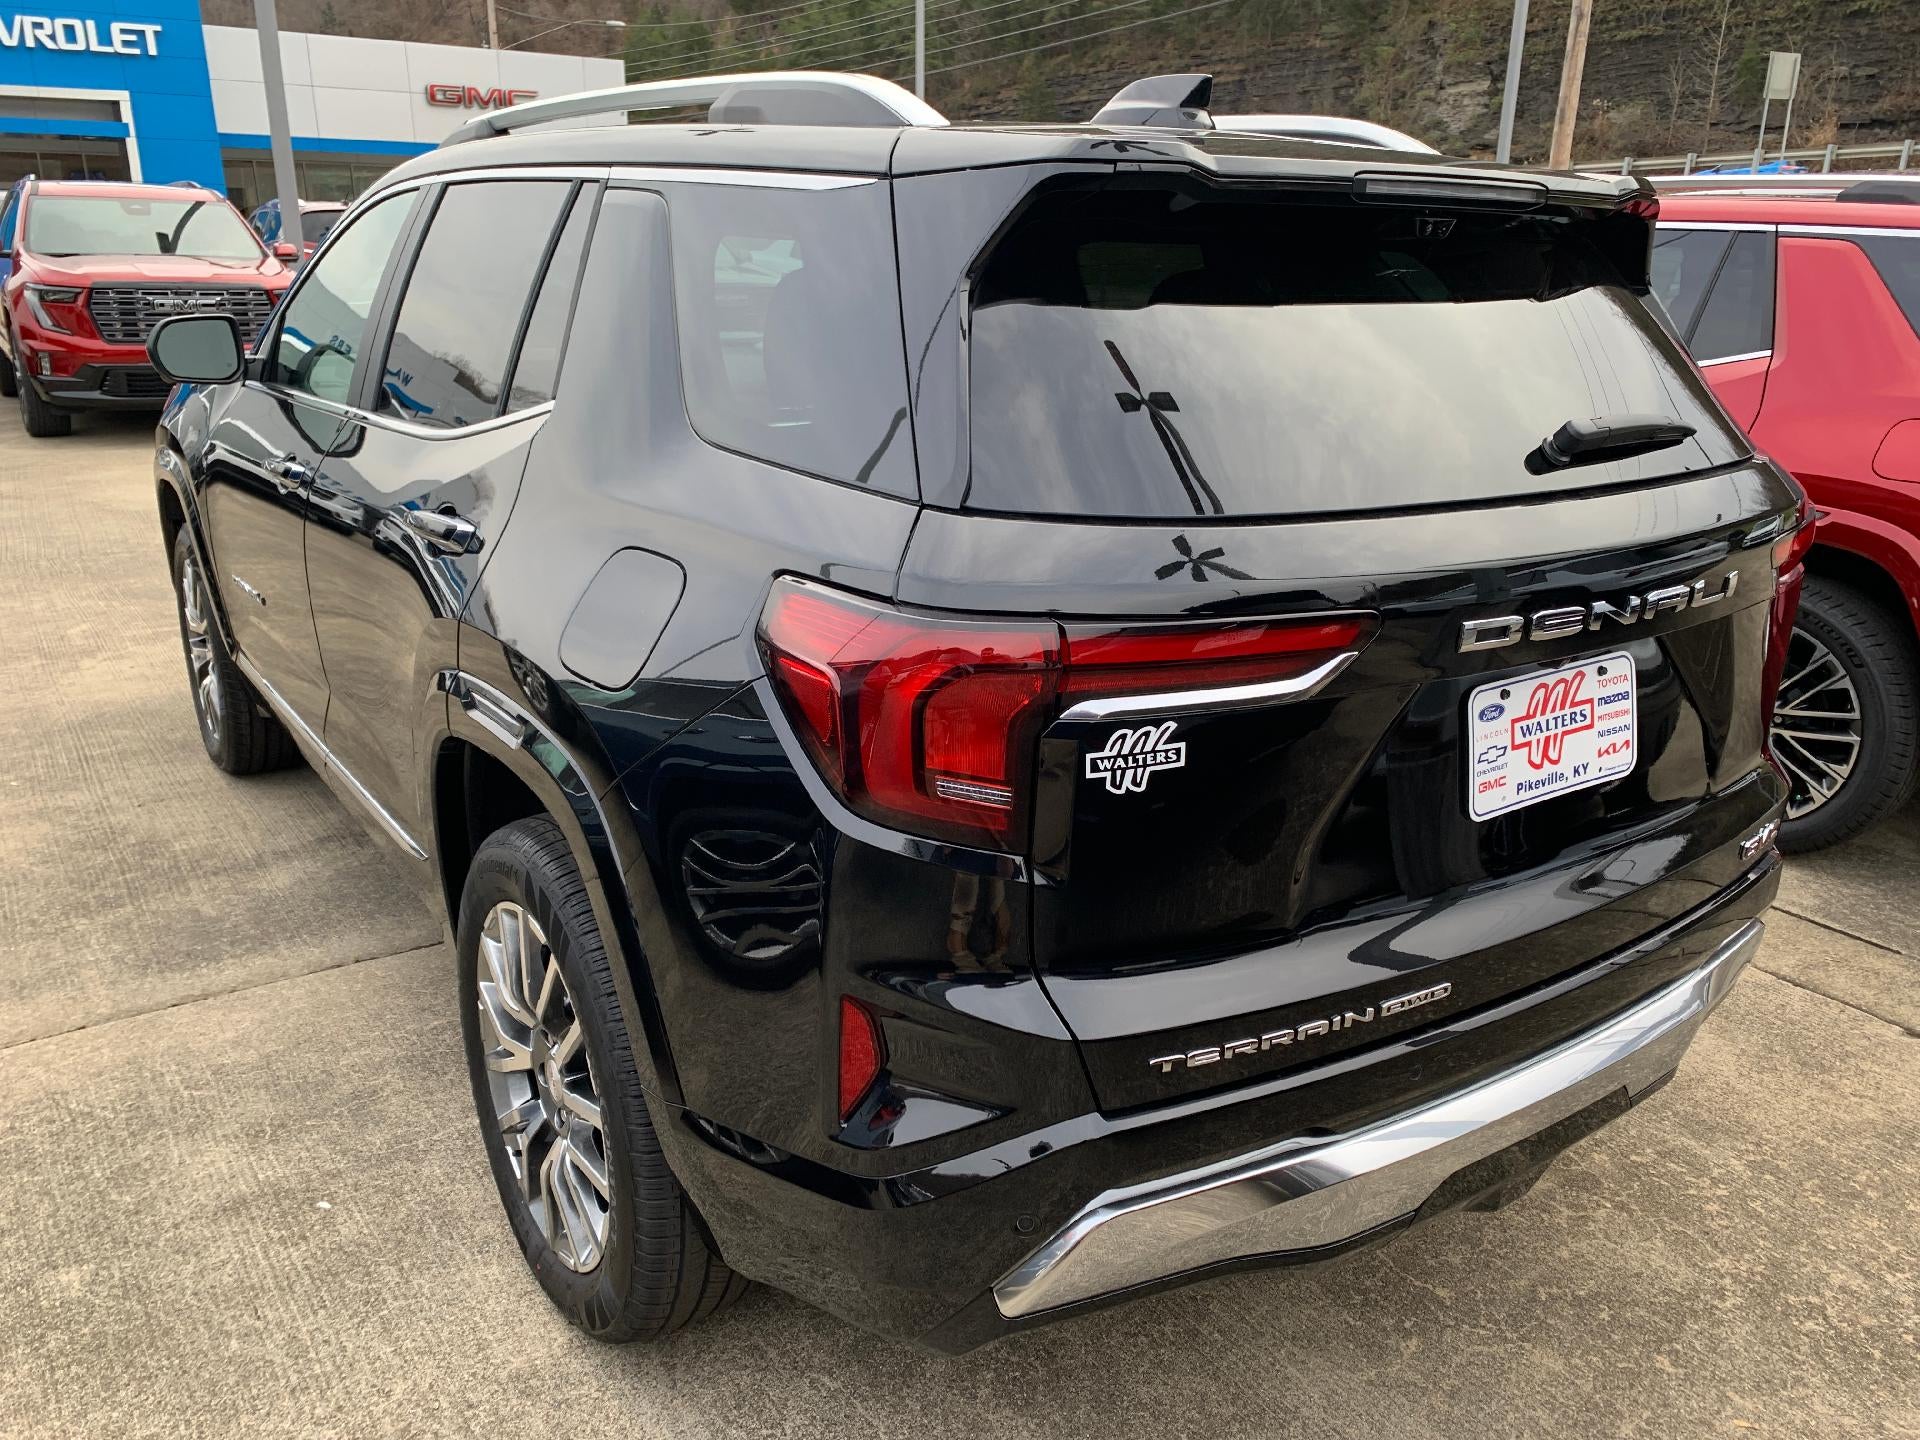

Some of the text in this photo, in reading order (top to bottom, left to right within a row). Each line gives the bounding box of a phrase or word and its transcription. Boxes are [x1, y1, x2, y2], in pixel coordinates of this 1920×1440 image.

[153, 299, 217, 312] GMC
[1458, 570, 1739, 653] DENALI
[1597, 673, 1629, 689] TOYOTA
[1519, 708, 1588, 739] WALTERS
[1597, 708, 1631, 723] MITSUBISHI
[1475, 727, 1509, 743] LINCOLN
[1597, 723, 1631, 739] NISSAN
[1096, 749, 1178, 771] WALTERS
[1476, 762, 1508, 778] CHEVROLET
[1478, 775, 1507, 794] GMC
[1516, 771, 1569, 796] Pikeville,
[1573, 762, 1590, 778] KY
[1149, 983, 1452, 1073] TERRAIN AWD
